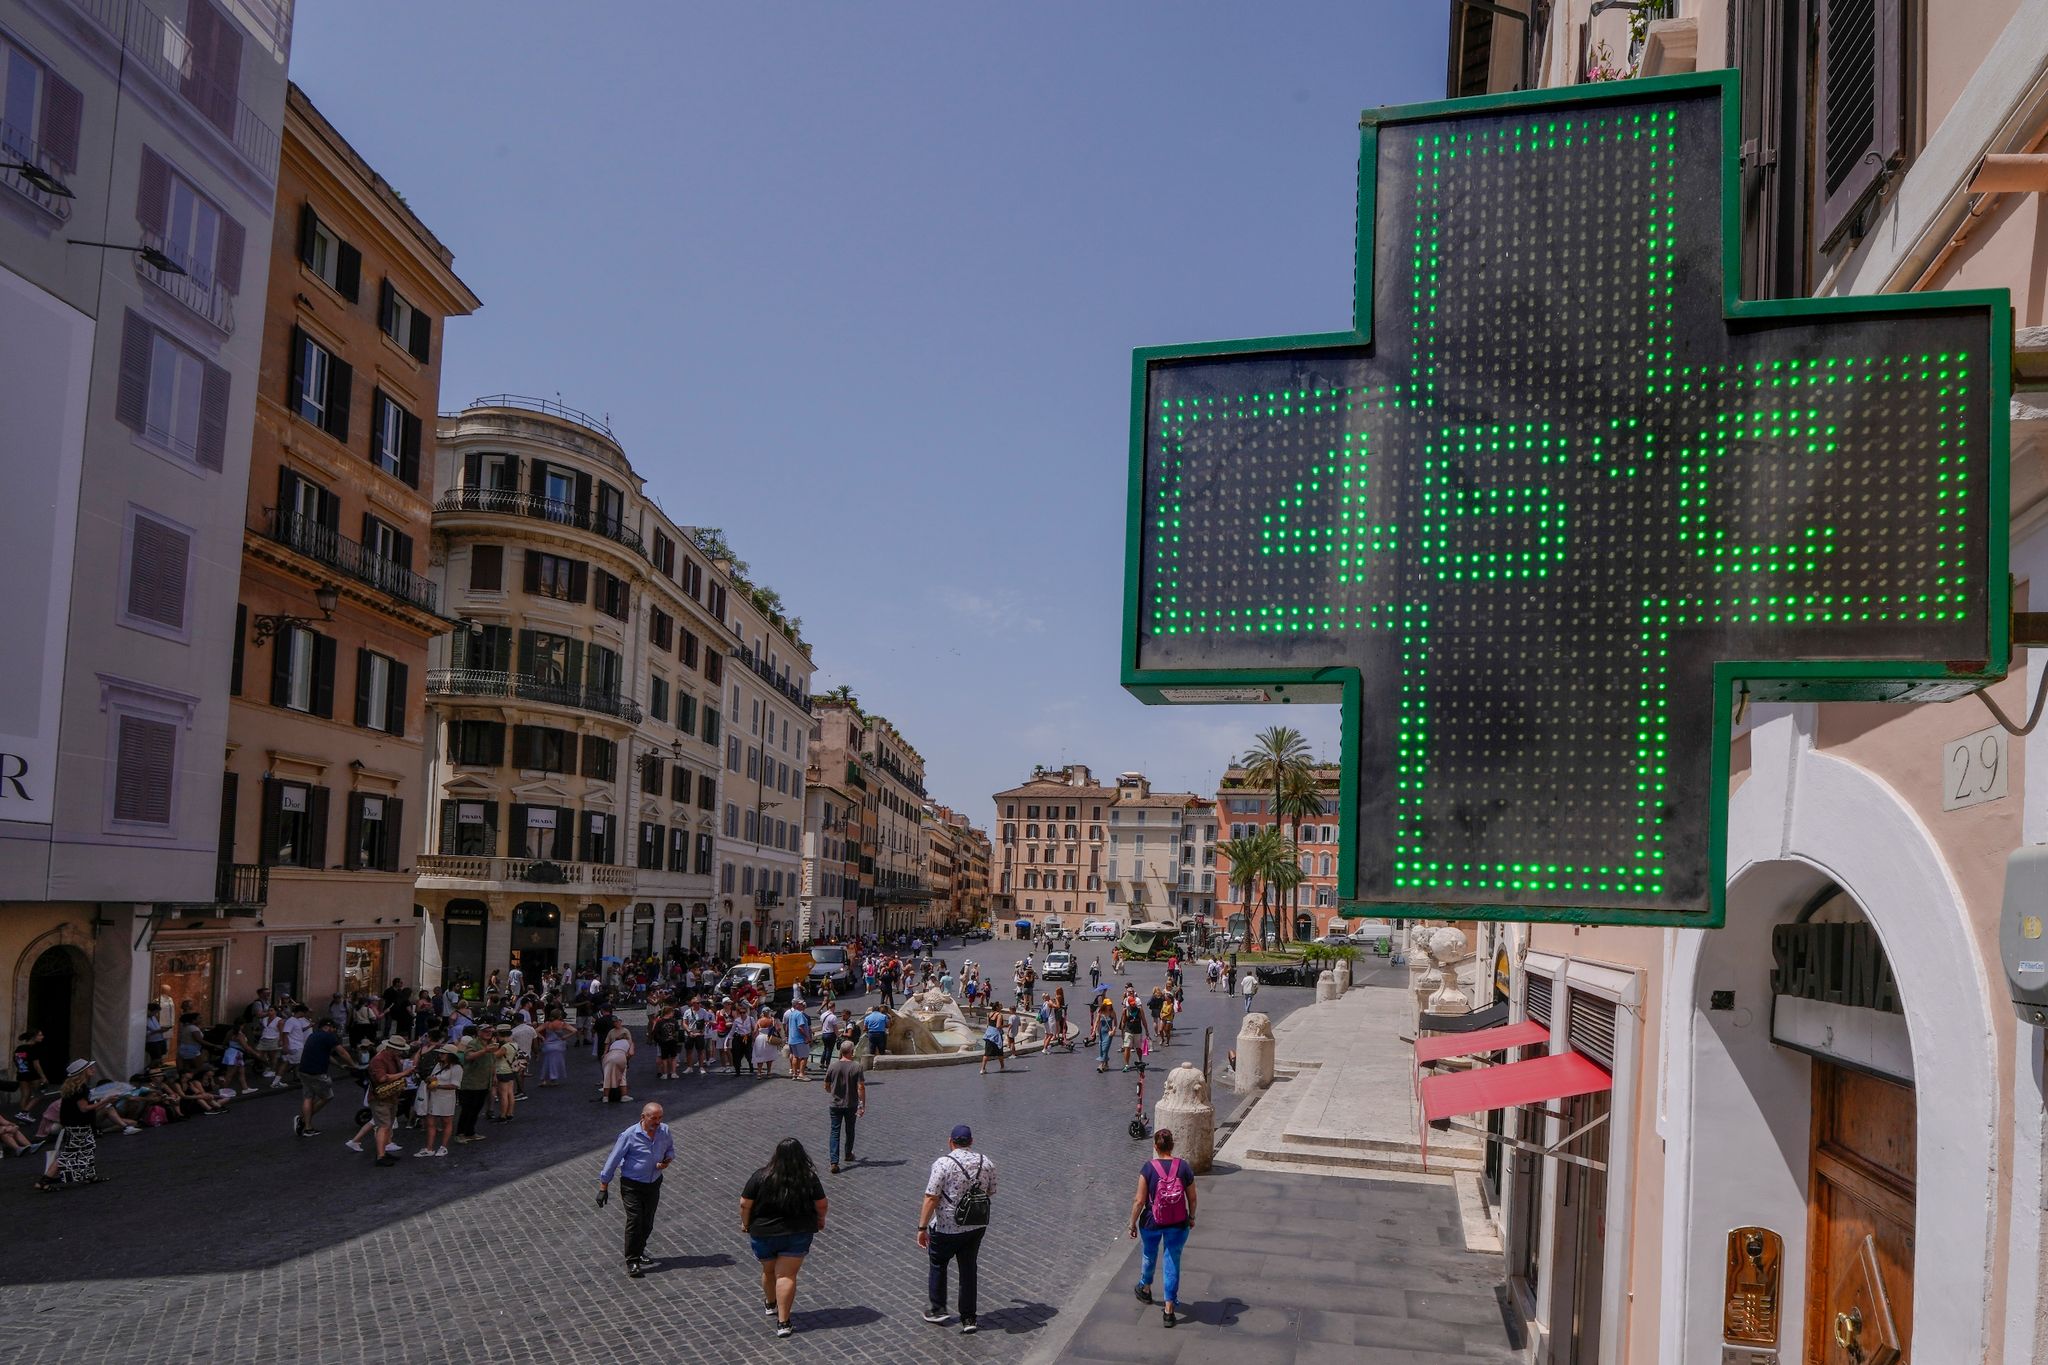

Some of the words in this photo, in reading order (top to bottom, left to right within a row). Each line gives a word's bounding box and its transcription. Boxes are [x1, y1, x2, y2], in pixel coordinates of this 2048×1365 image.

[1952, 735, 1998, 800] 29
[284, 797, 301, 808] Dior
[364, 807, 378, 817] Dior
